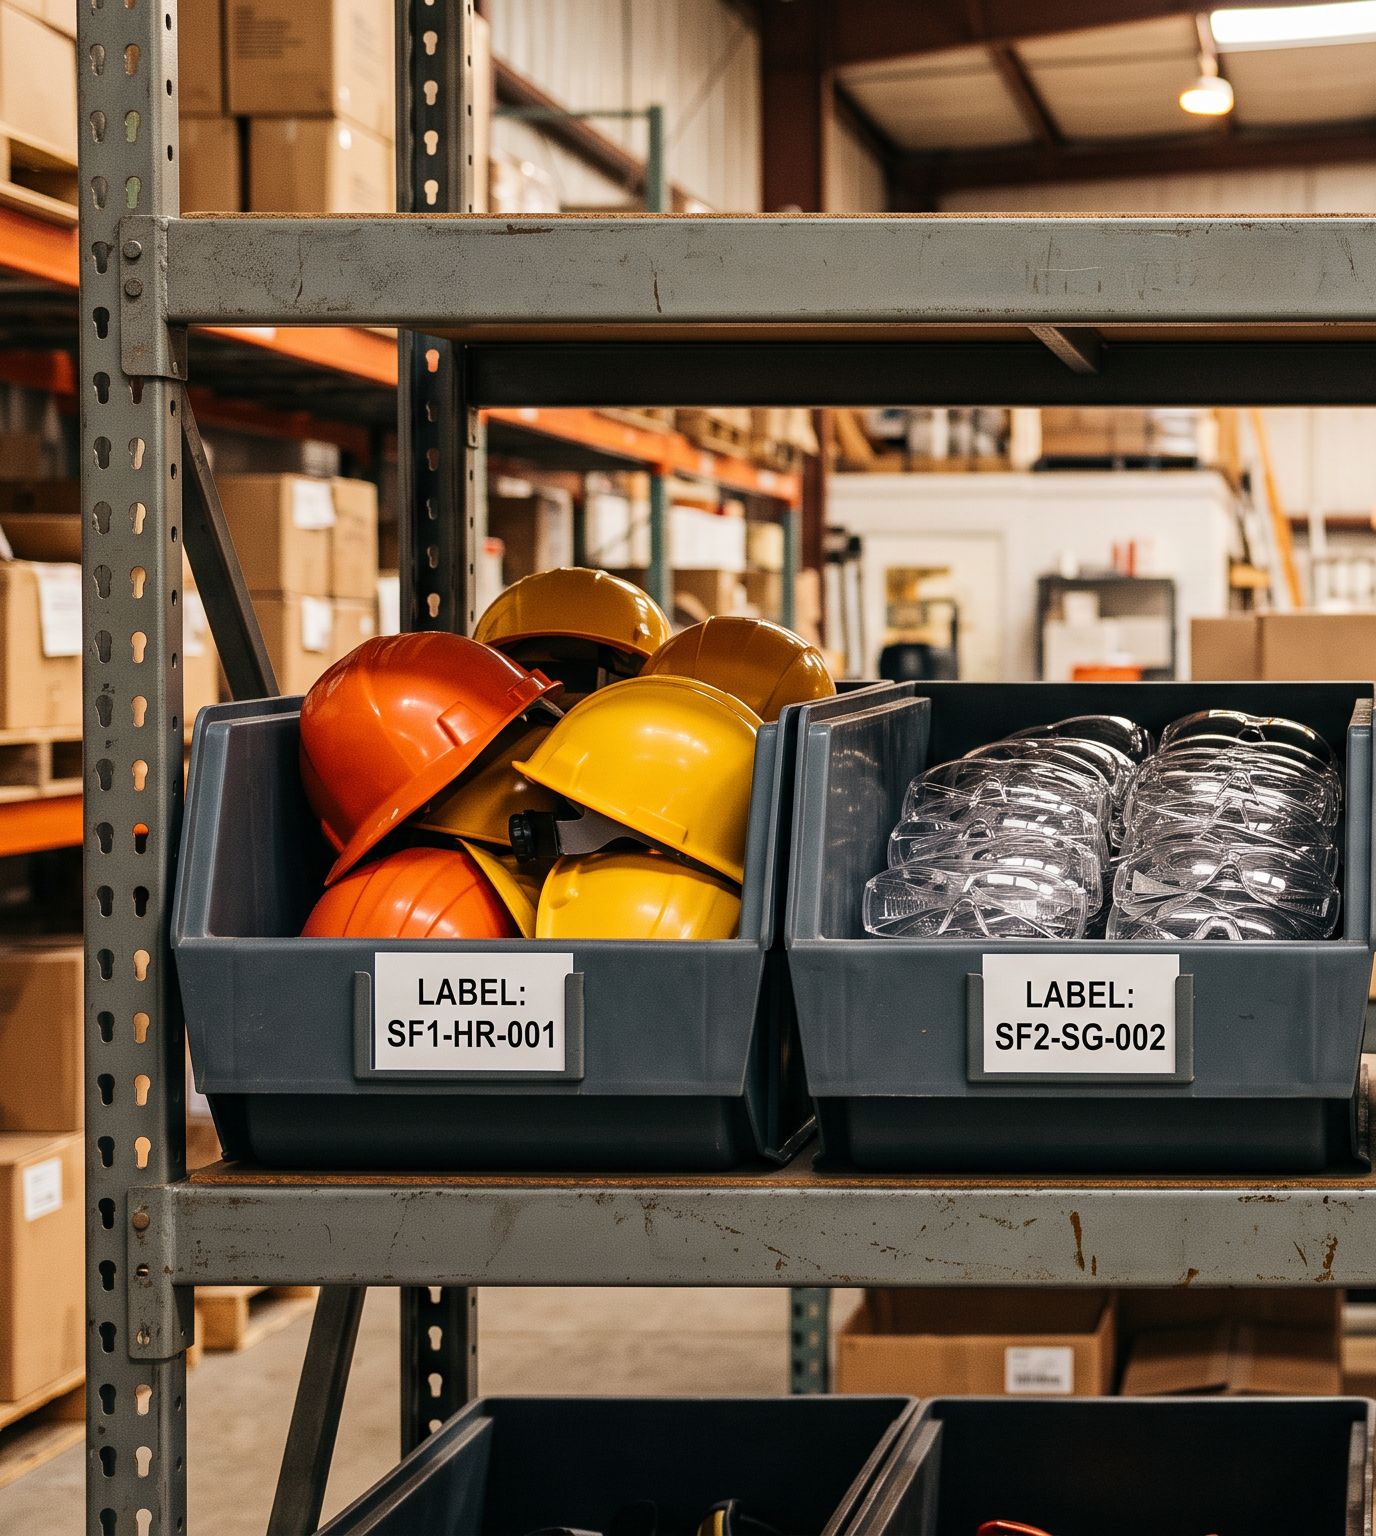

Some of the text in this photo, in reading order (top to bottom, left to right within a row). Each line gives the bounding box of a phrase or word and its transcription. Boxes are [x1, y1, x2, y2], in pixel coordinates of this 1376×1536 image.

[418, 978, 526, 1006] LABEL:
[1026, 980, 1134, 1009] LABEL:
[387, 1019, 555, 1049] SF1-HR-001
[995, 1022, 1166, 1051] SF2-SG-002
